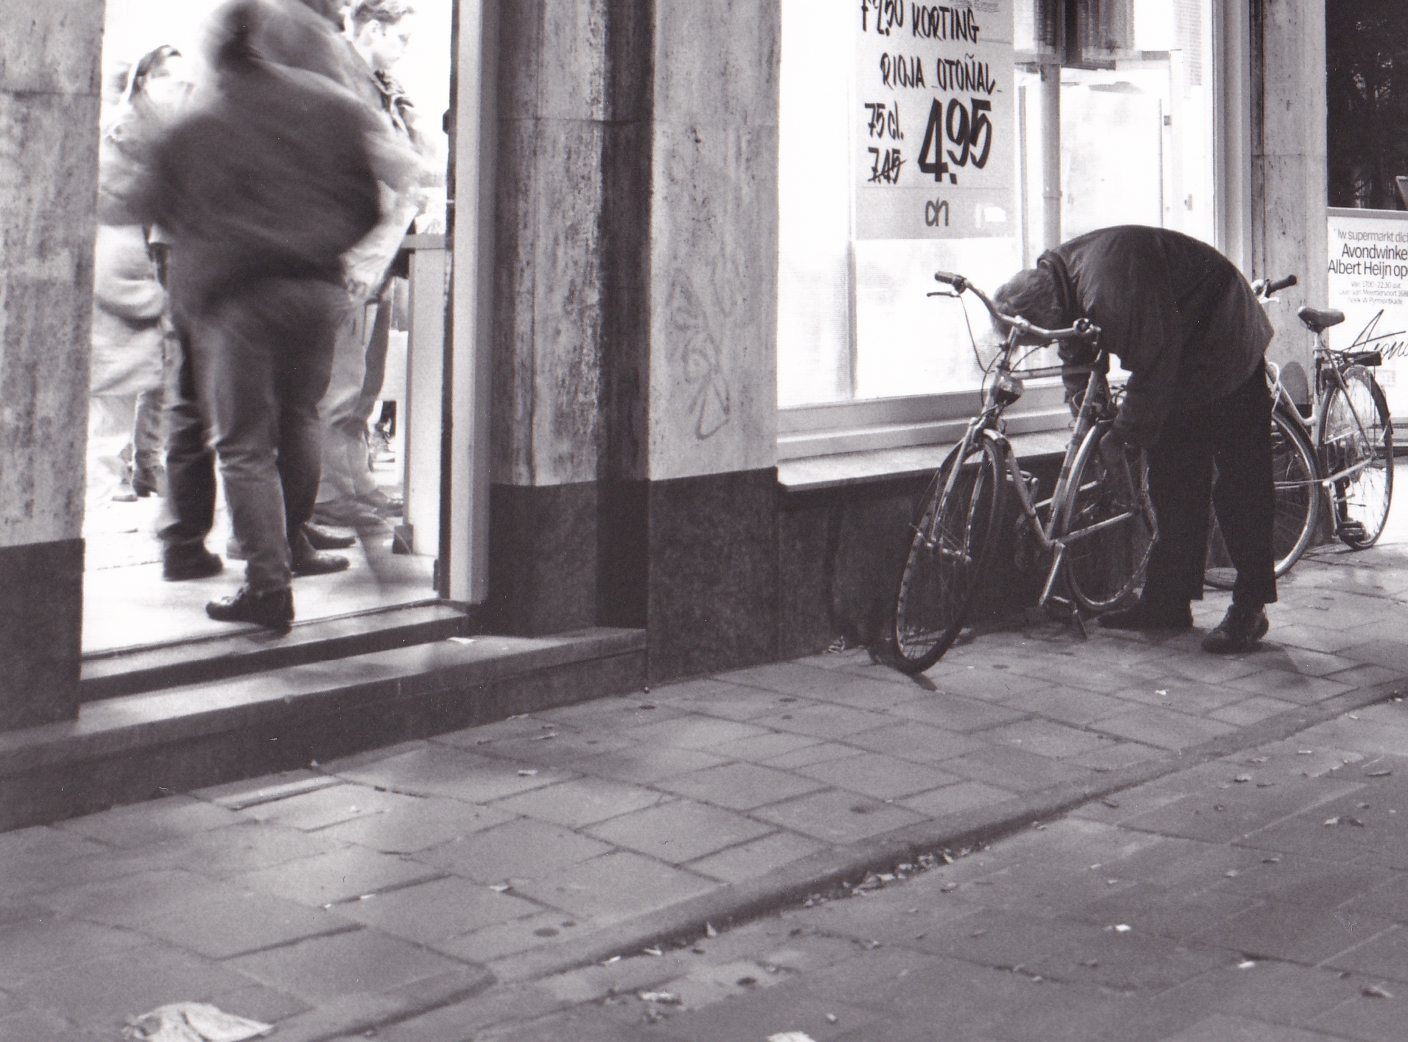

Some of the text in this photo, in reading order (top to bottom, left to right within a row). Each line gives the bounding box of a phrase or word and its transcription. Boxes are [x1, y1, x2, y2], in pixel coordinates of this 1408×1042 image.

[911, 1, 980, 44] KORTING
[880, 51, 925, 91] RIOJA
[918, 96, 993, 185] 4.95
[1348, 230, 1394, 243] supermarkt
[1328, 259, 1362, 275] Albert
[1363, 261, 1392, 279] Heijn
